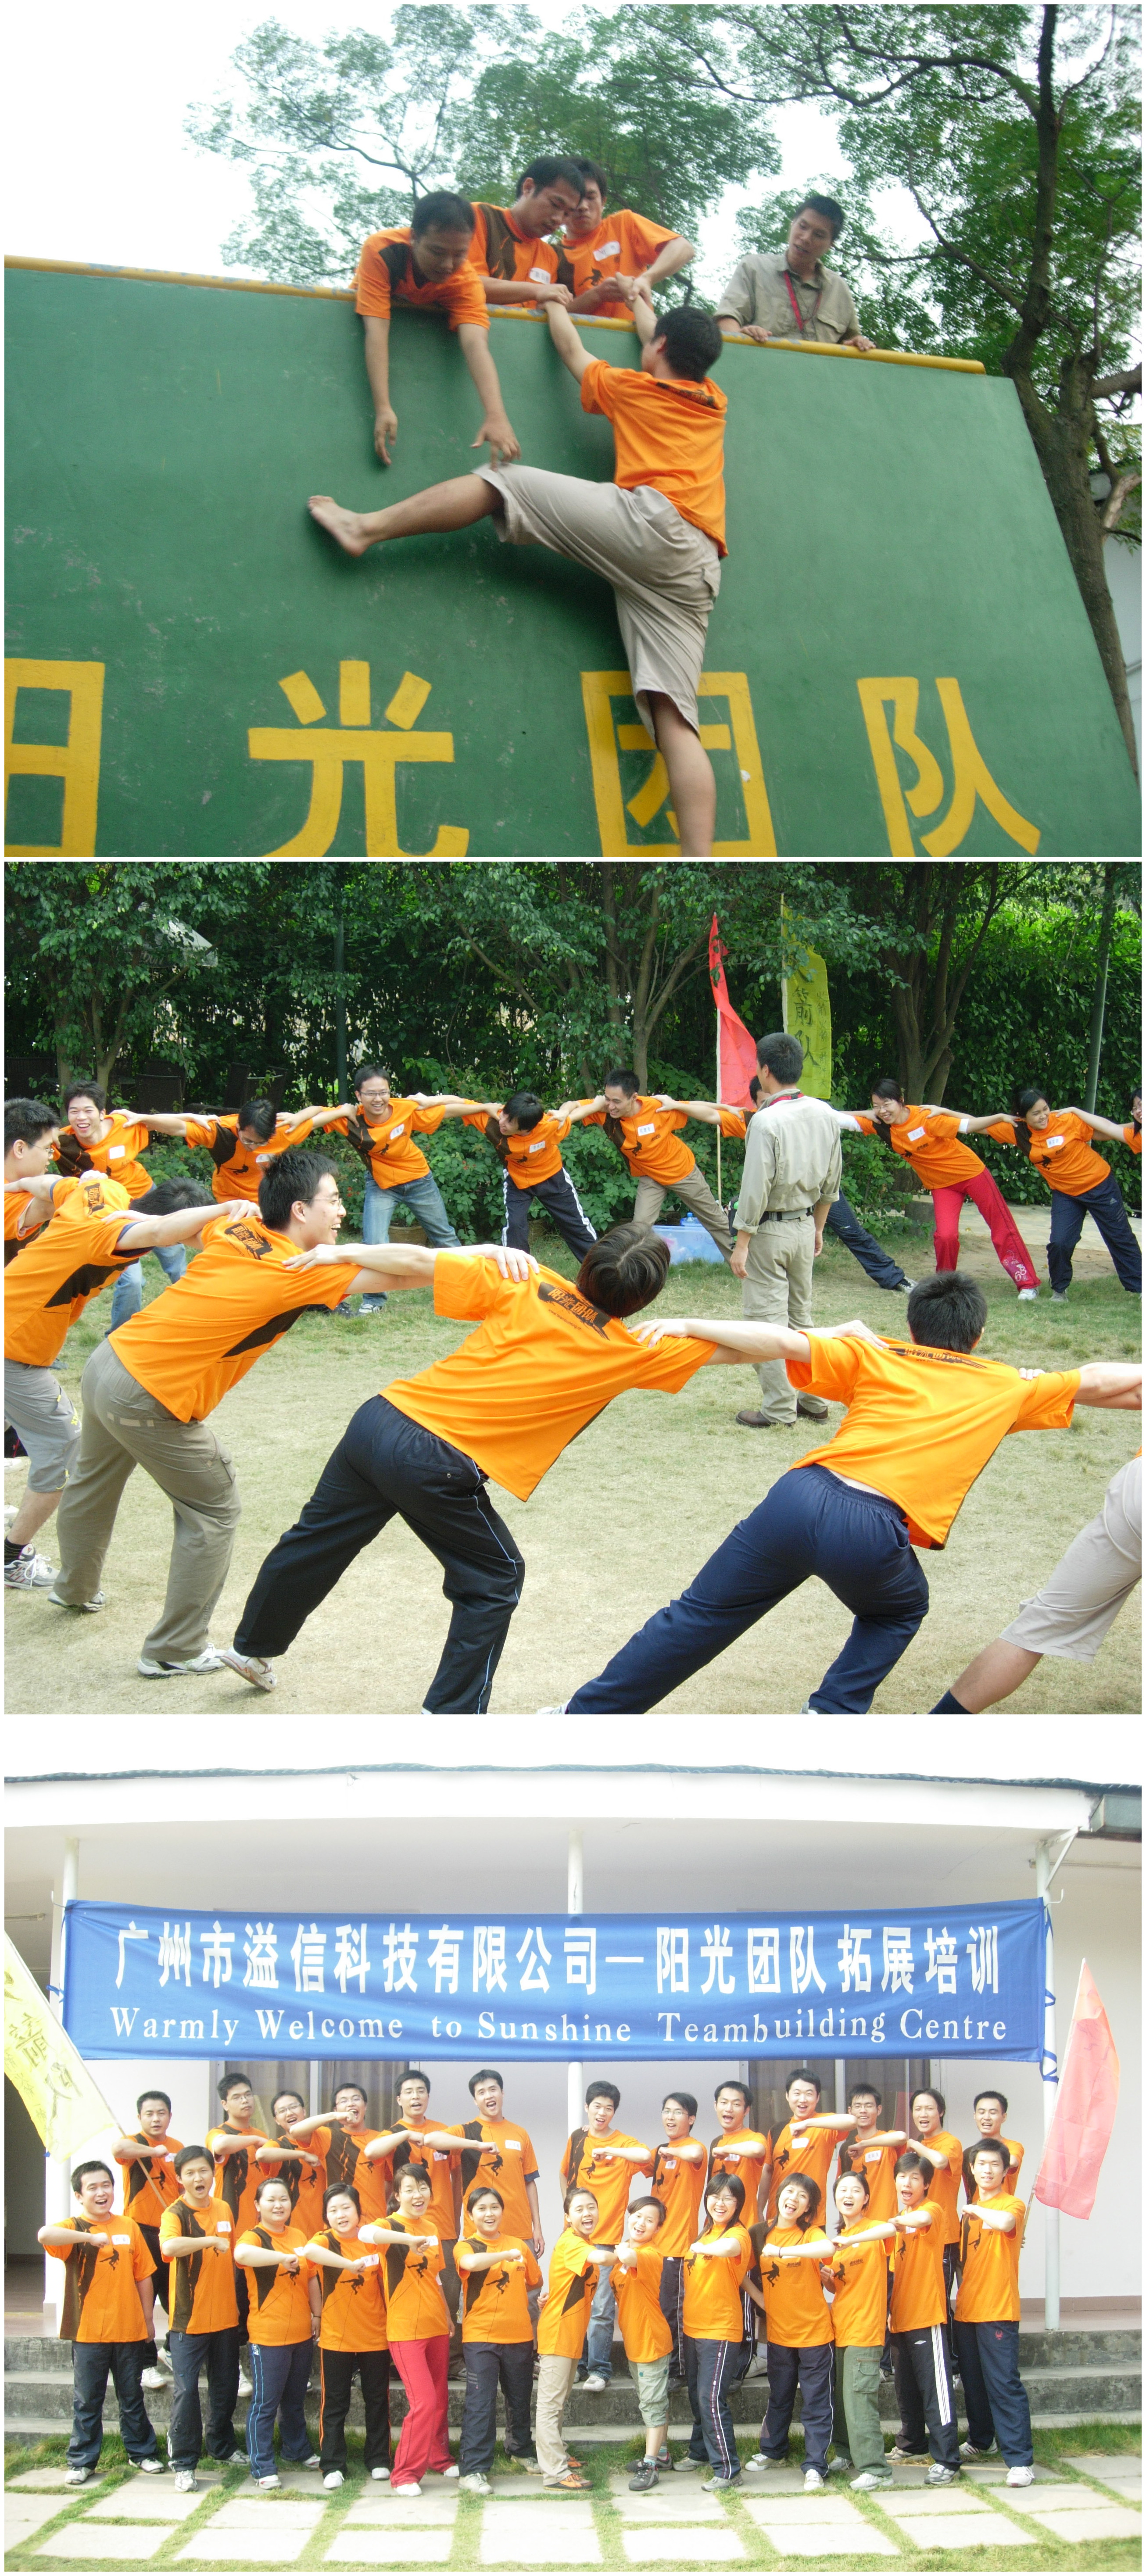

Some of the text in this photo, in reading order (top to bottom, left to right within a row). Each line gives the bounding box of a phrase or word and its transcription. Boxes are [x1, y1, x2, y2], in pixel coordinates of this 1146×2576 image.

[548, 1288, 598, 1323] 阳光团队
[110, 2007, 1006, 2046] Warmly Welcome to Sunshine Teambuilding Centre
